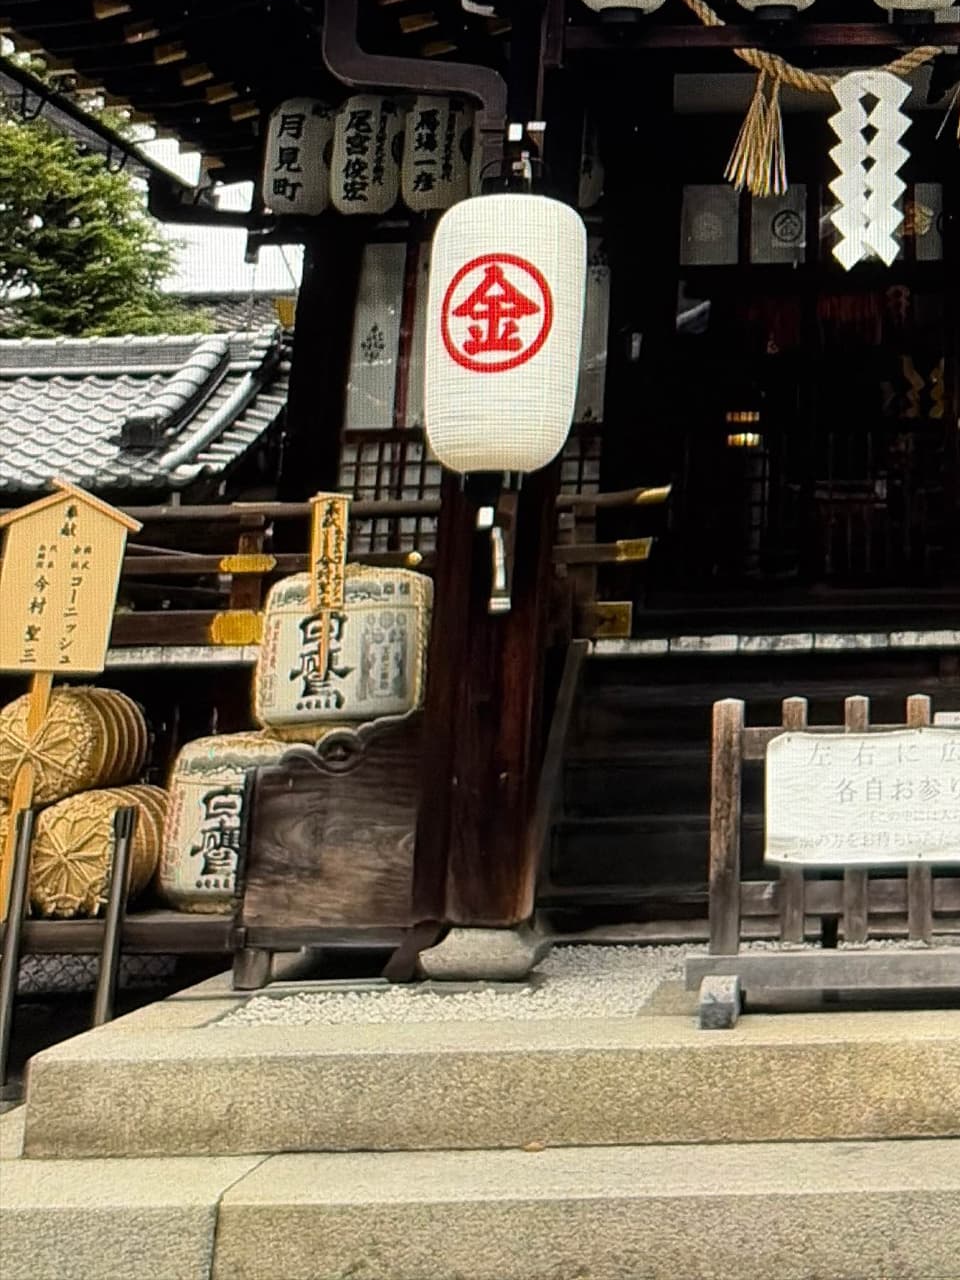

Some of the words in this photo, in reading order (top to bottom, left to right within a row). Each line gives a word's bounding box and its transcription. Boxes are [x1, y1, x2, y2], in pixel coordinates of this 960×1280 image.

[272, 113, 306, 202] 月見町
[452, 263, 541, 356] 金
[19, 575, 50, 663] 今村聖三
[59, 576, 83, 664] コーニッシュ
